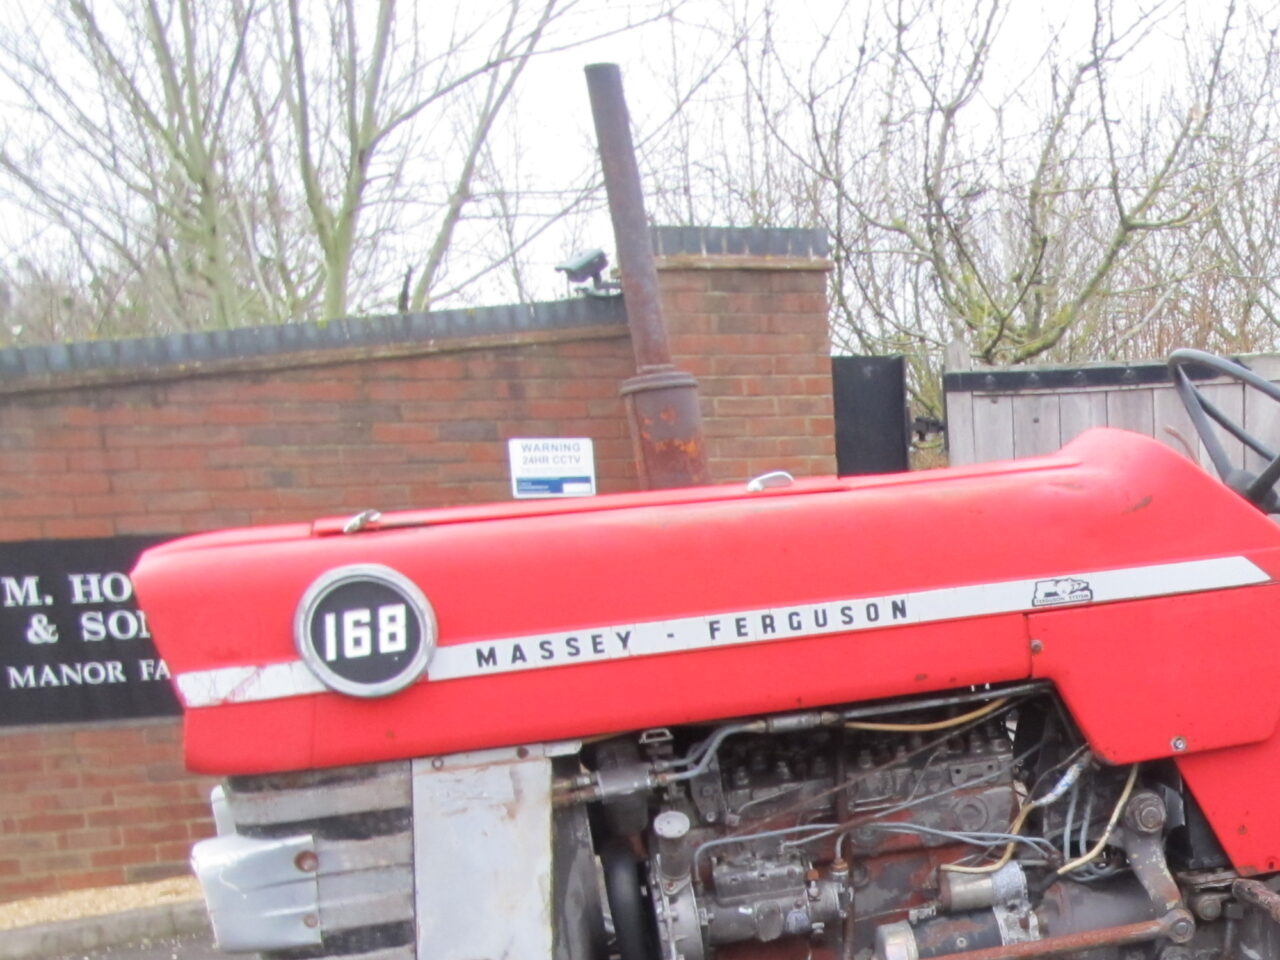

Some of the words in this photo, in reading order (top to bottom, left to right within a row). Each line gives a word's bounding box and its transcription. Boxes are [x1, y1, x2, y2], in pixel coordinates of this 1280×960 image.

[521, 443, 580, 453] WARNING
[522, 455, 549, 465] 24HR
[552, 455, 581, 464] CCTV
[1, 576, 54, 608] M.
[68, 571, 133, 604] HO
[27, 613, 59, 644] &
[324, 603, 406, 662] 168
[476, 630, 632, 668] MASSEY
[709, 599, 908, 641] FERGUSON
[6, 660, 126, 689] MANOR
[139, 658, 172, 682] FA
